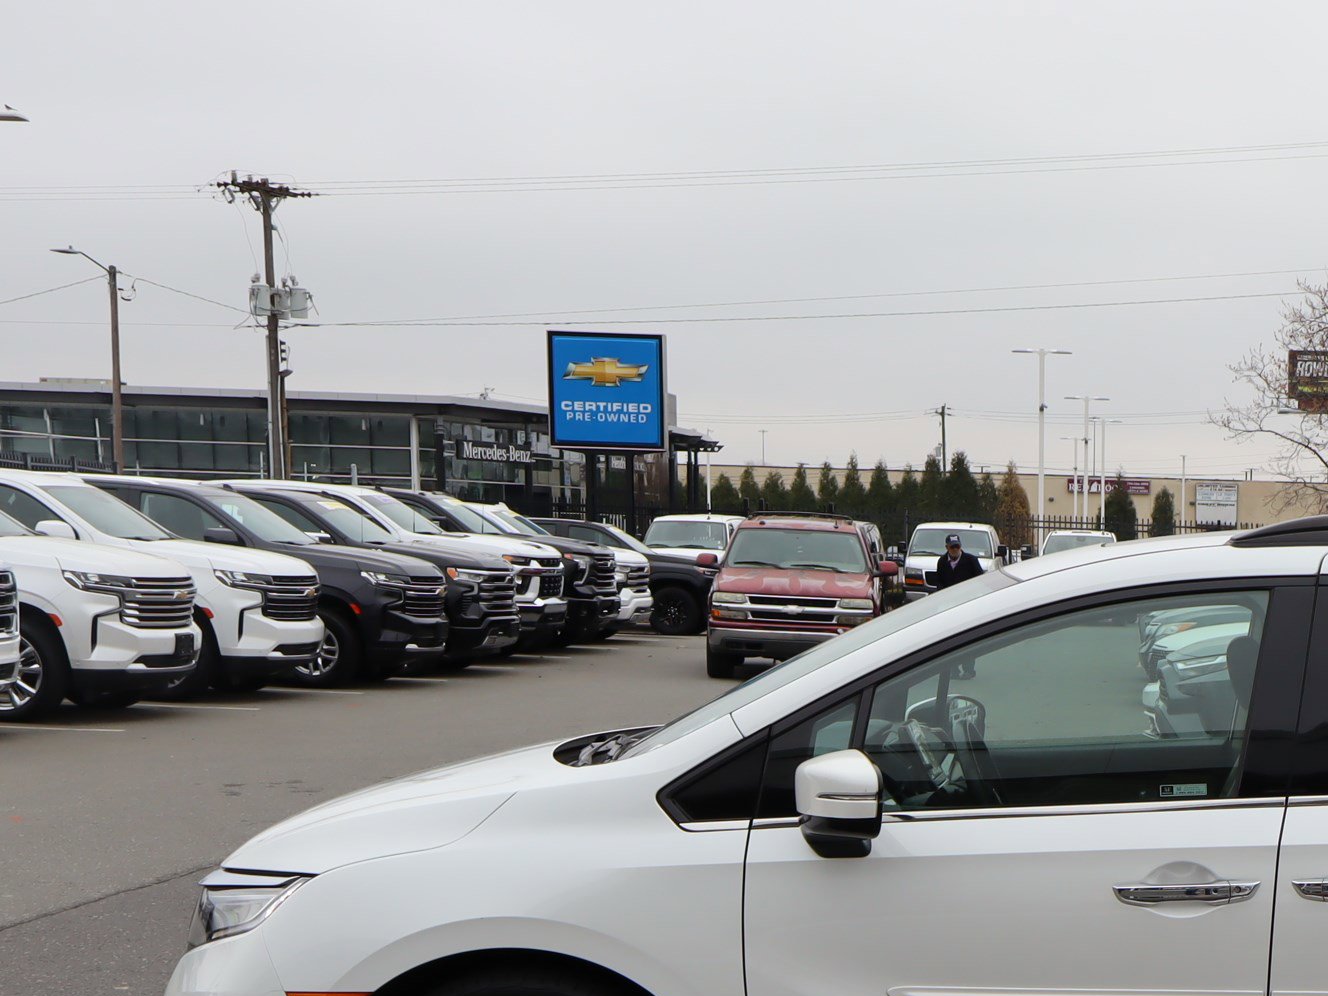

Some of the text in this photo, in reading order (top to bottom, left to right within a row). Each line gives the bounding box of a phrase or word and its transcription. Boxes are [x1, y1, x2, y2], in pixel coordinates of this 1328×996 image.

[561, 401, 652, 413] CERTIFIED
[566, 412, 647, 423] PRE-OWNED
[463, 441, 532, 463] Mercedes-Benz
